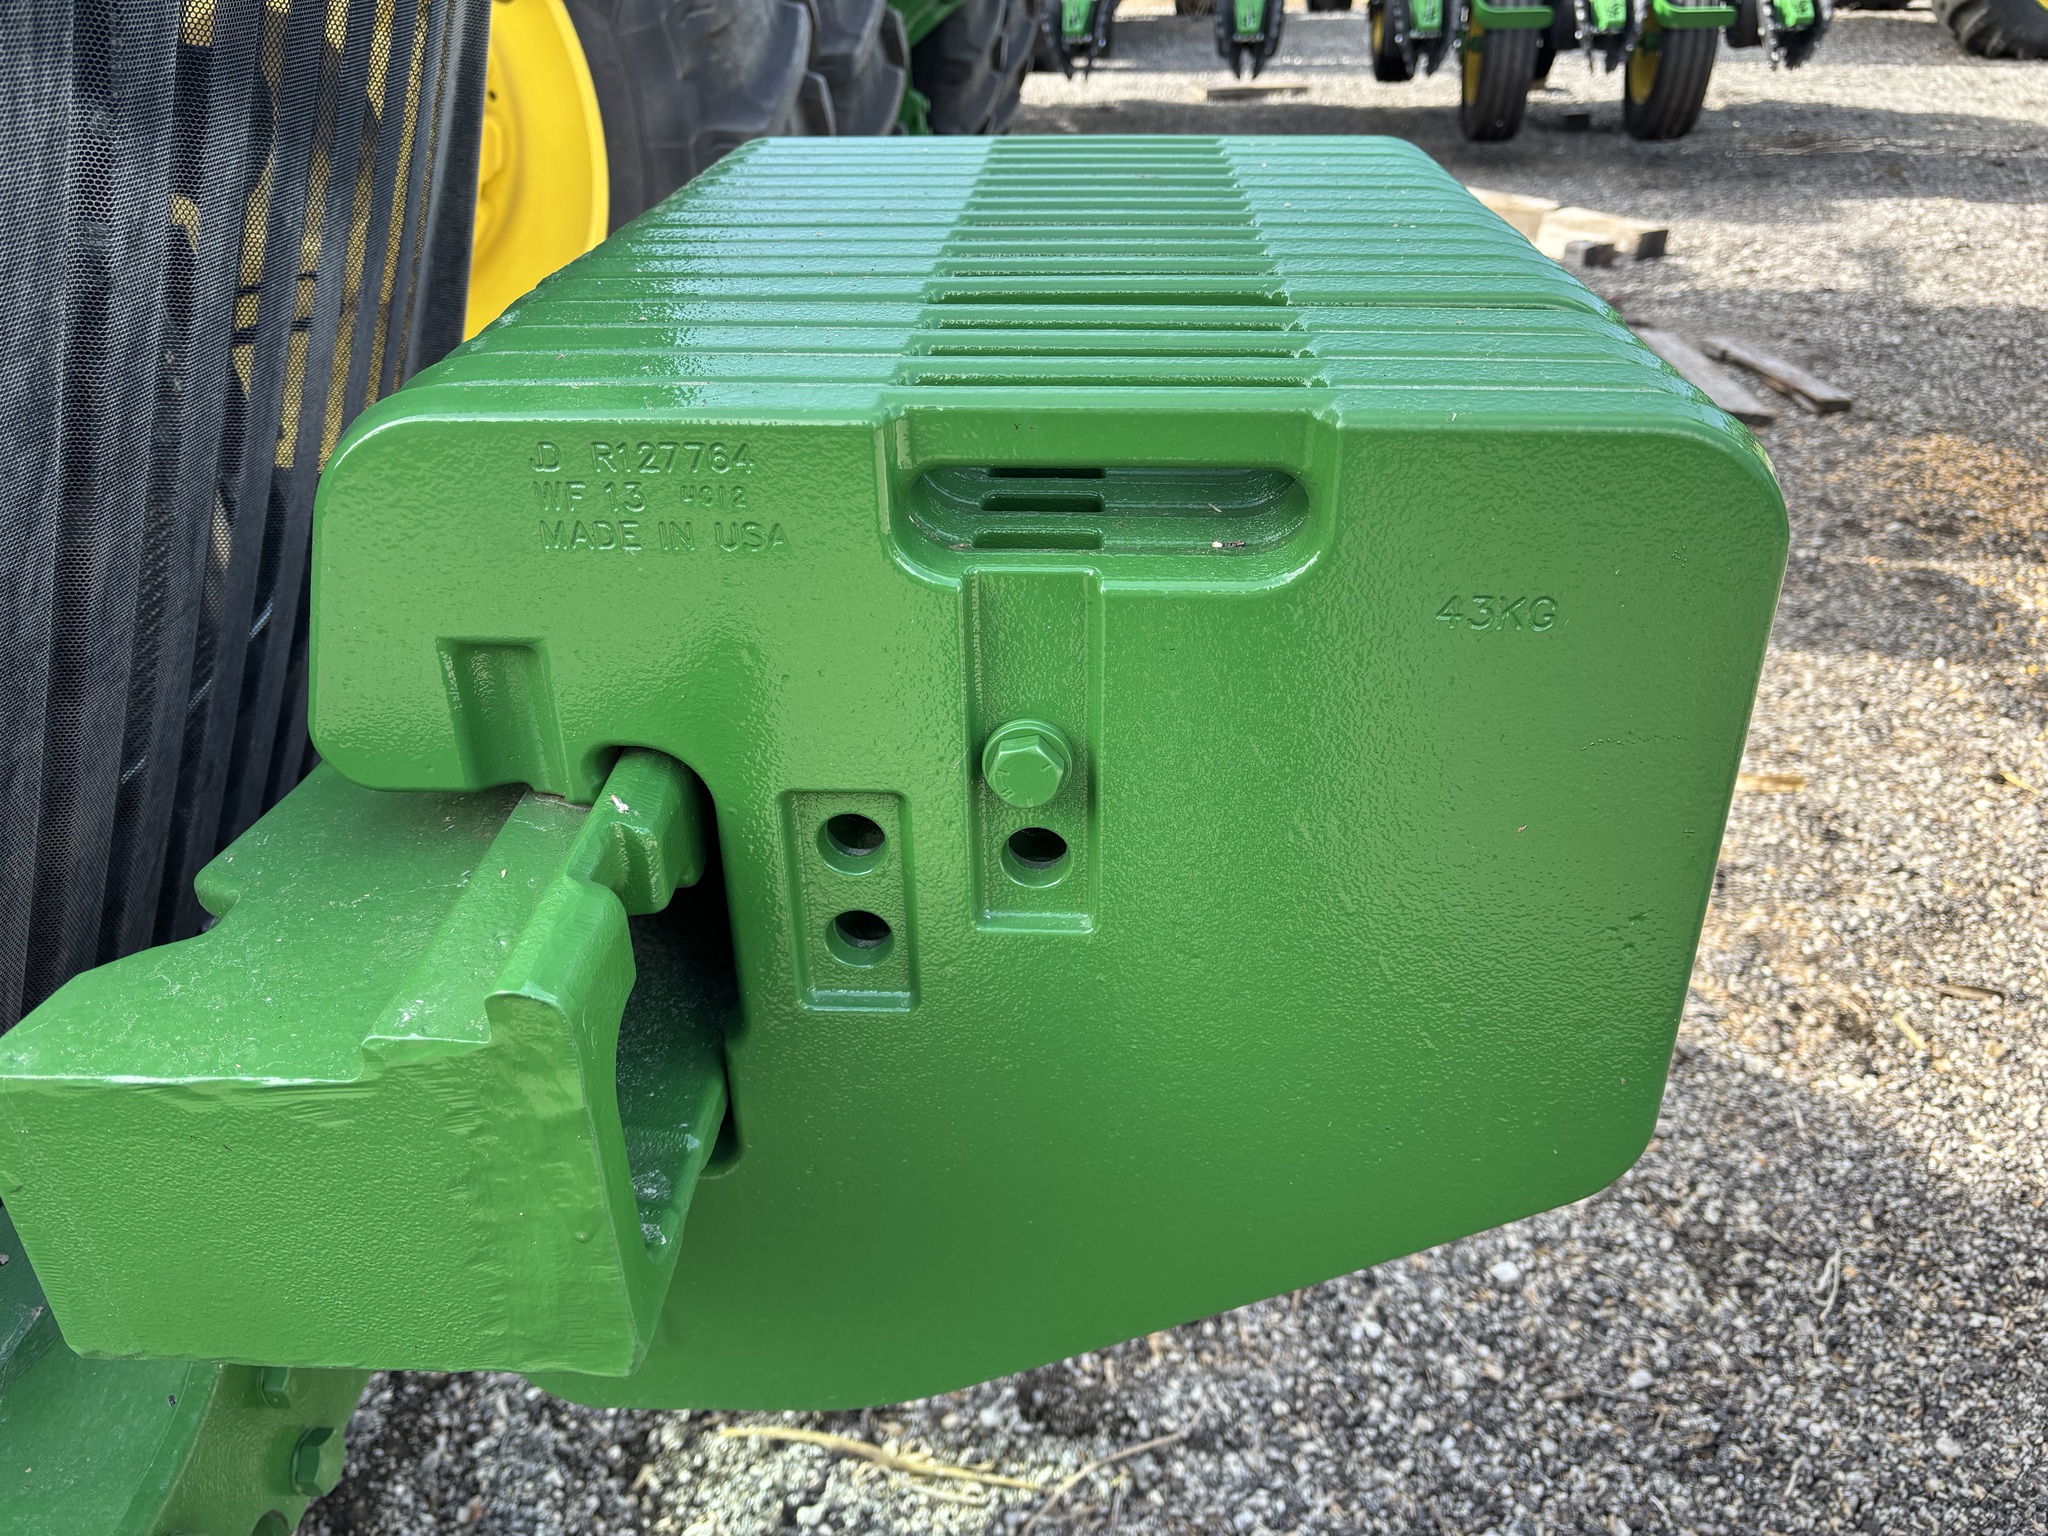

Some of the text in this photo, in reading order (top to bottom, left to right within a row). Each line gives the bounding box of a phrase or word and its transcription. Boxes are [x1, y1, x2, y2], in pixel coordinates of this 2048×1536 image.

[590, 441, 756, 474] R127764
[532, 480, 586, 511] WF
[602, 480, 646, 512] 13
[539, 519, 791, 551] MADE IN USA
[1435, 594, 1559, 632] 43KG
